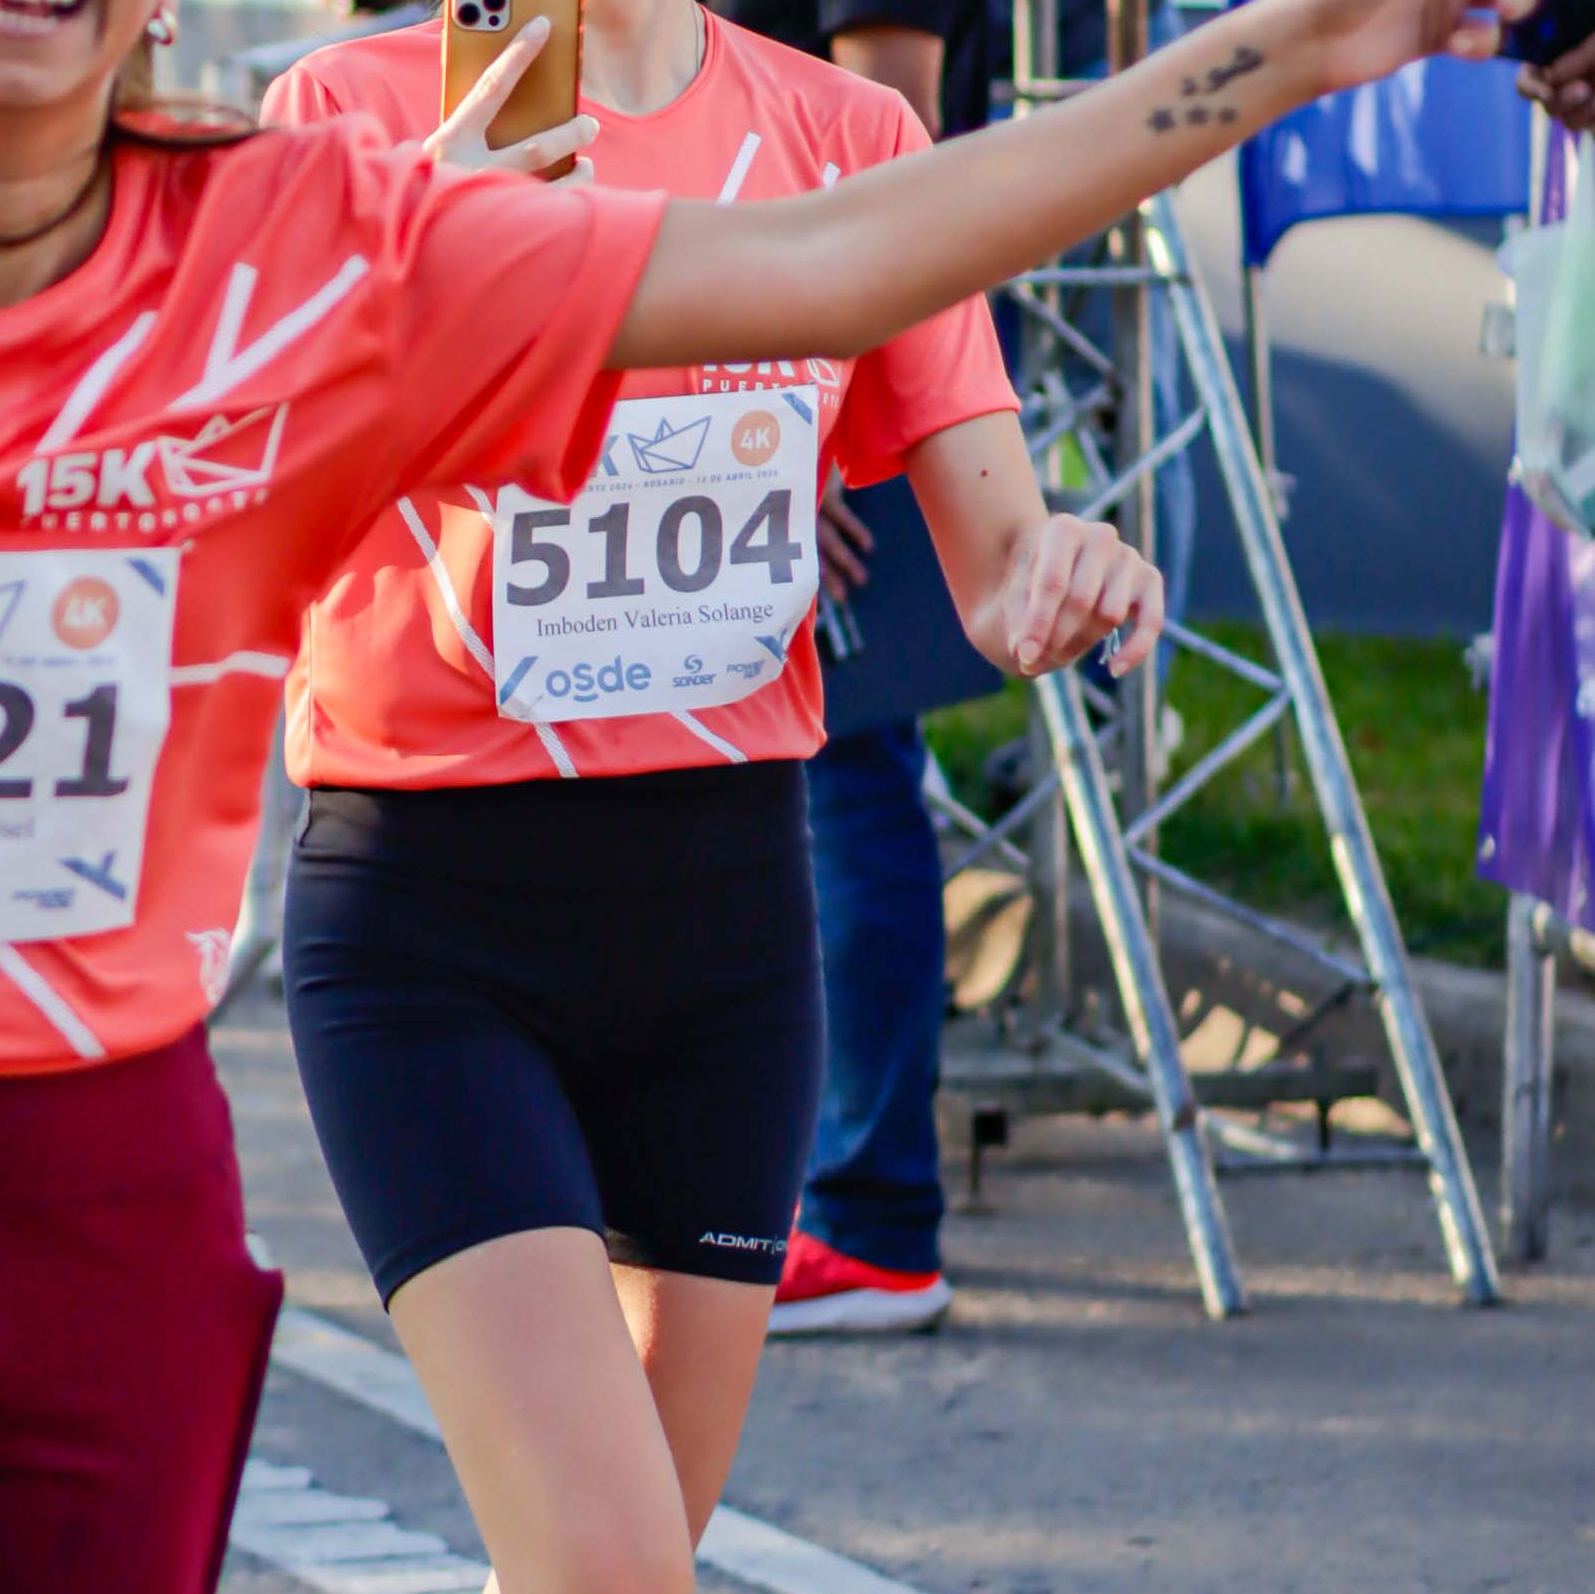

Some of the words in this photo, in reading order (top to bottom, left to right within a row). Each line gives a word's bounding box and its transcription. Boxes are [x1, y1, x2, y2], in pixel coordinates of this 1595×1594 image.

[740, 426, 771, 450] 4K
[17, 440, 156, 517] 15K
[507, 488, 803, 606] 5104
[64, 597, 106, 628] 4K
[537, 613, 618, 638] Imboden
[624, 607, 693, 629] Valeria
[698, 602, 774, 624] Solange
[545, 655, 652, 703] osde
